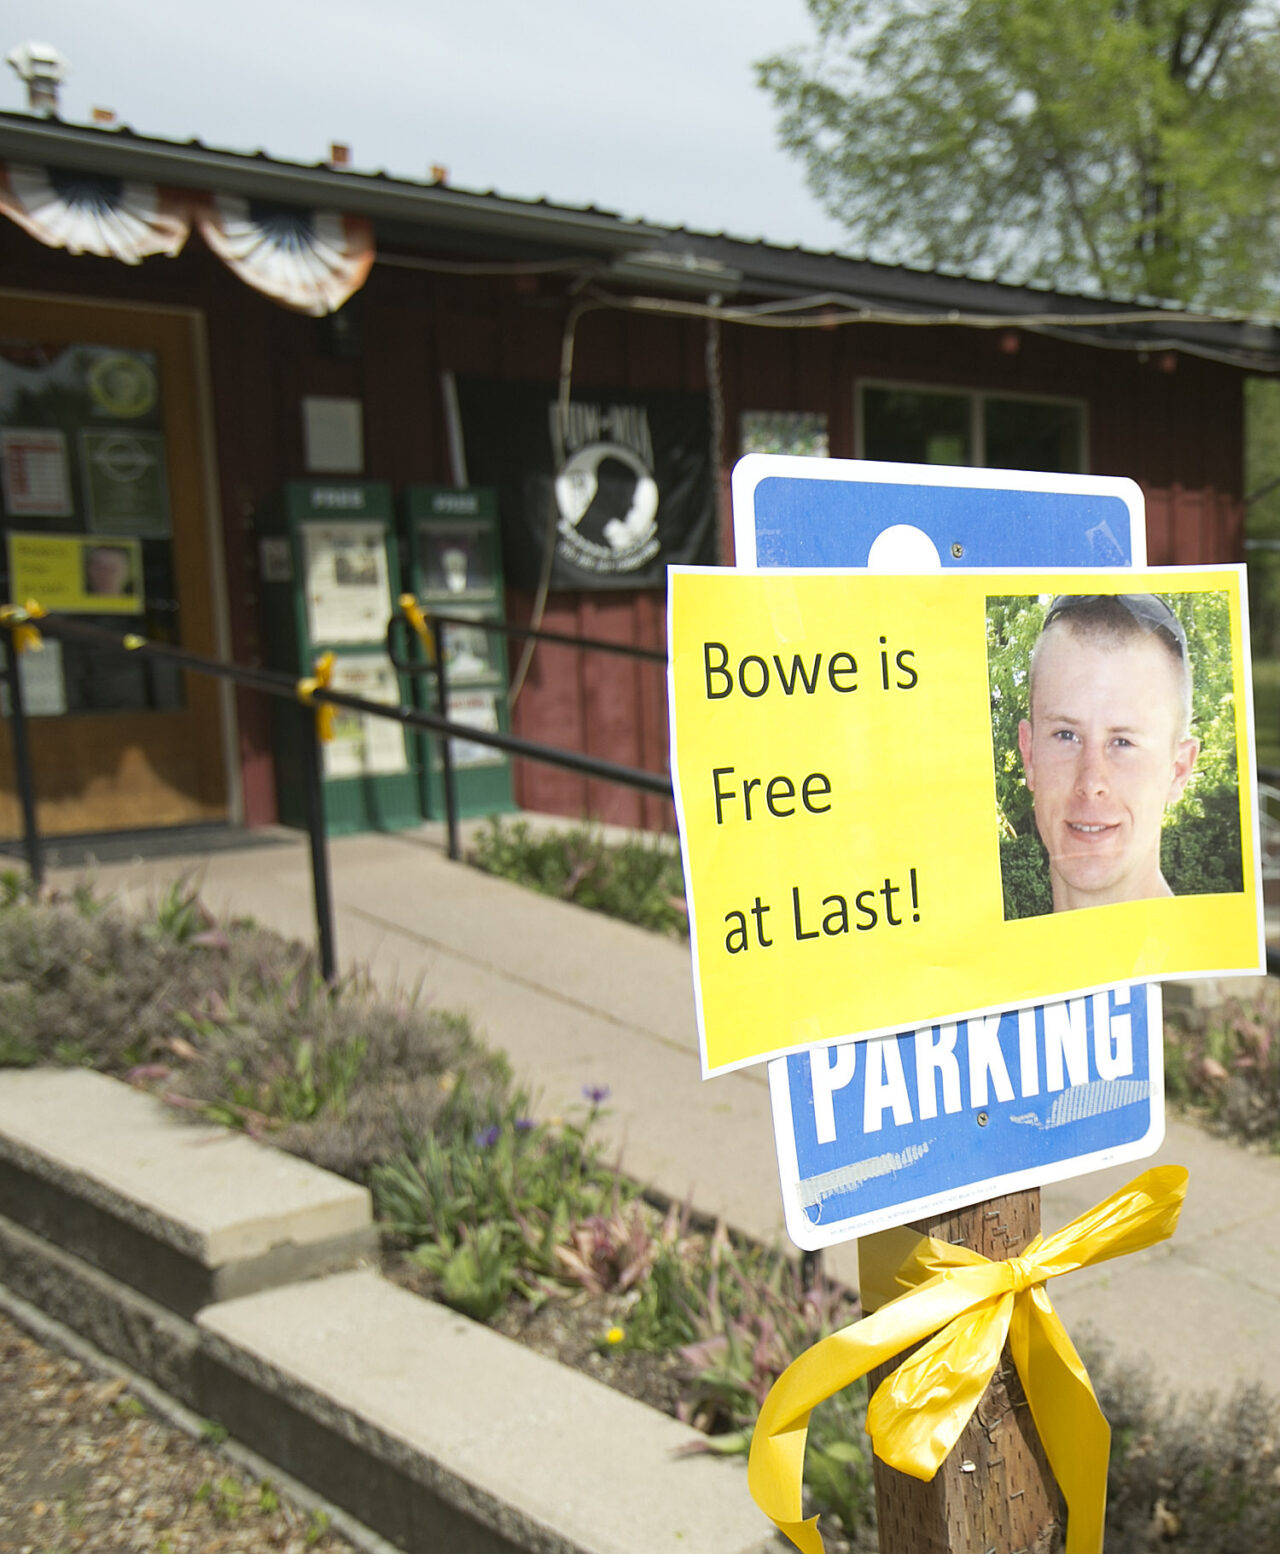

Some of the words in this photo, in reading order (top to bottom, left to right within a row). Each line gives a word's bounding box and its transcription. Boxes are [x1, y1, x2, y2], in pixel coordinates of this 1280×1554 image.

[703, 642, 858, 699] Bowe
[880, 636, 919, 690] is
[712, 764, 832, 824] Free
[724, 896, 772, 952] at
[792, 868, 921, 942] Last!
[811, 988, 1134, 1145] PARKING
